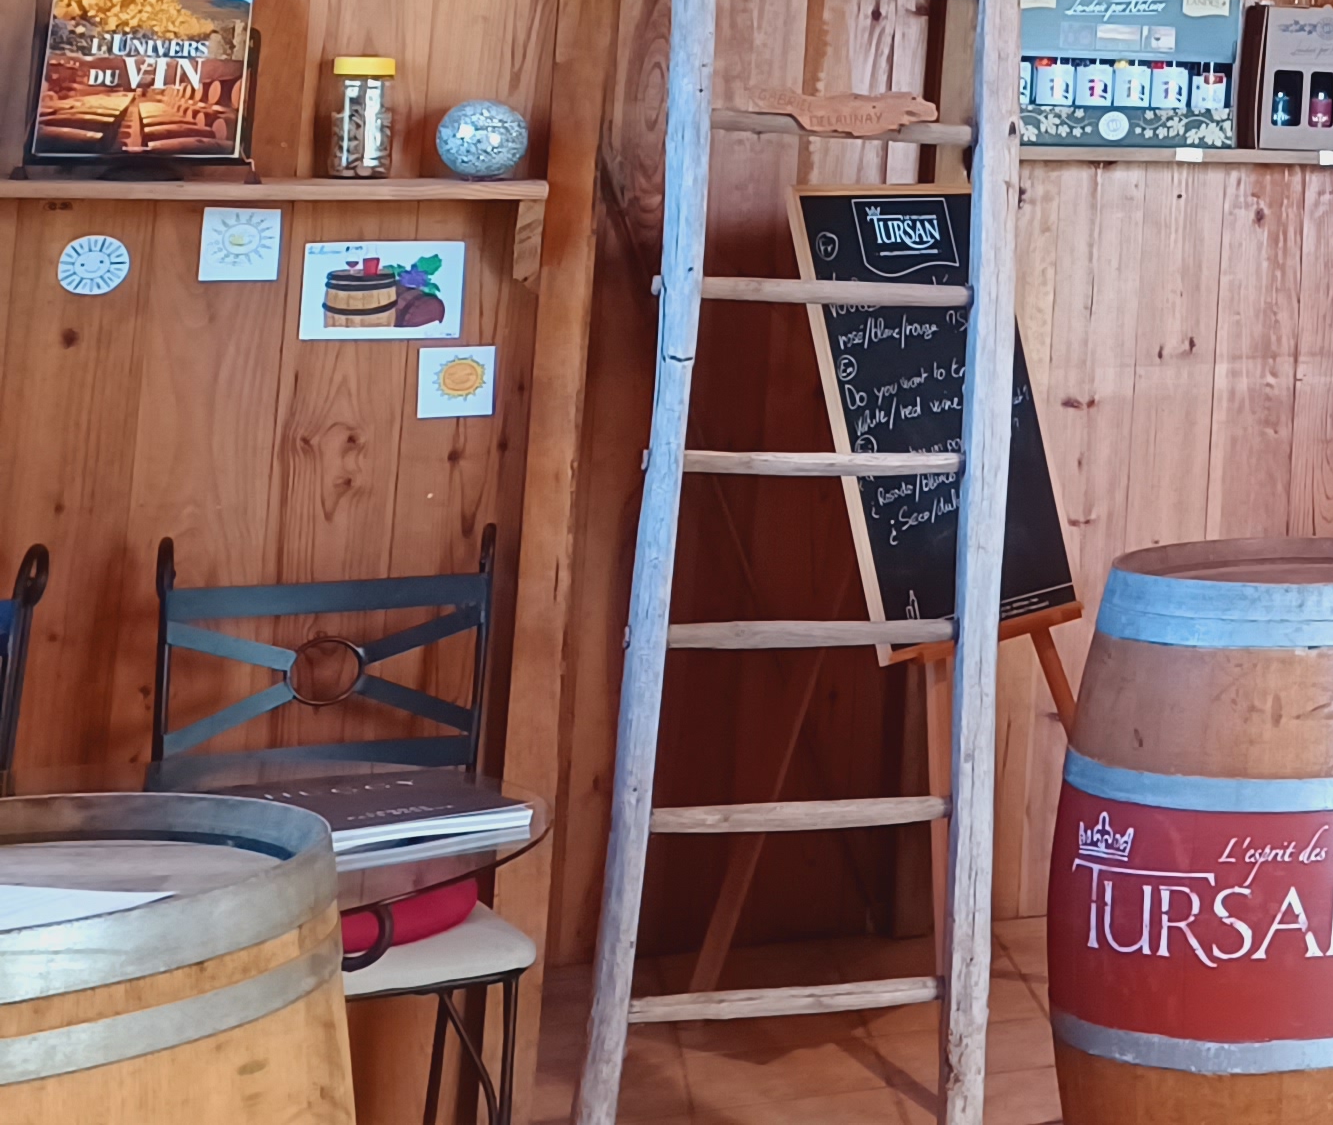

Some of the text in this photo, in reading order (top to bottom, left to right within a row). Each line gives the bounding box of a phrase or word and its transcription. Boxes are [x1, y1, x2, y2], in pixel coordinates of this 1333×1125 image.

[88, 56, 207, 91] DU VIN
[757, 87, 813, 112] GABRIEL
[809, 111, 883, 126] DELAUNAY
[867, 215, 941, 249] TURSAN
[844, 384, 867, 410] Do
[874, 382, 898, 406] you
[933, 361, 946, 381] to
[1219, 836, 1295, 889] L'esprit
[1298, 824, 1330, 864] des
